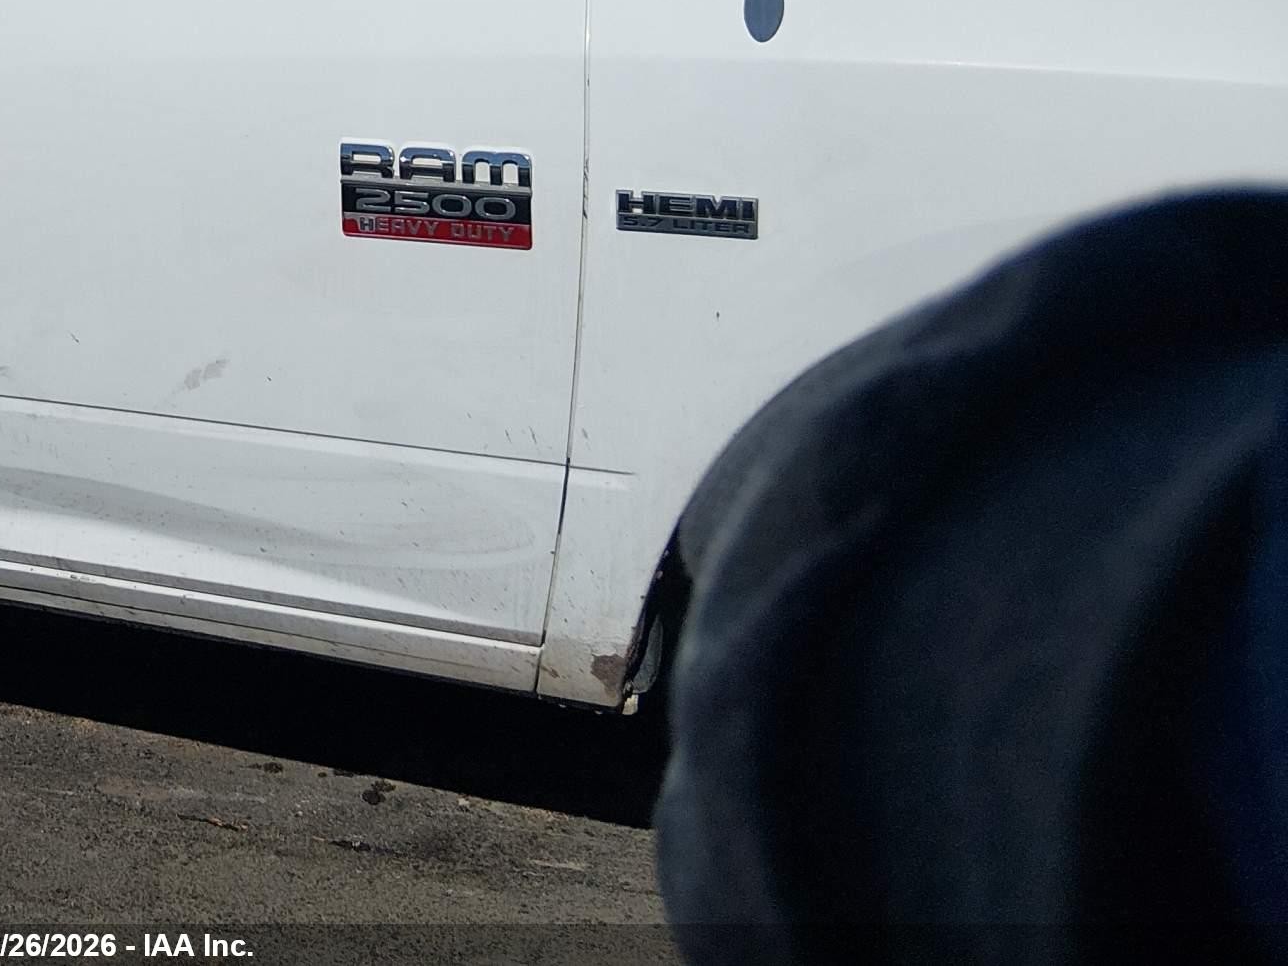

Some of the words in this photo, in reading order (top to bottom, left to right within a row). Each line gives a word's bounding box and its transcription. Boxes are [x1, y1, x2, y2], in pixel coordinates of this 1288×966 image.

[340, 142, 532, 187] RAM
[355, 188, 517, 220] 2500
[616, 190, 758, 221] HEMI
[360, 216, 440, 236] HEAVY
[451, 223, 515, 242] DUTY
[623, 215, 663, 228] 5.7
[672, 218, 750, 233] LITER
